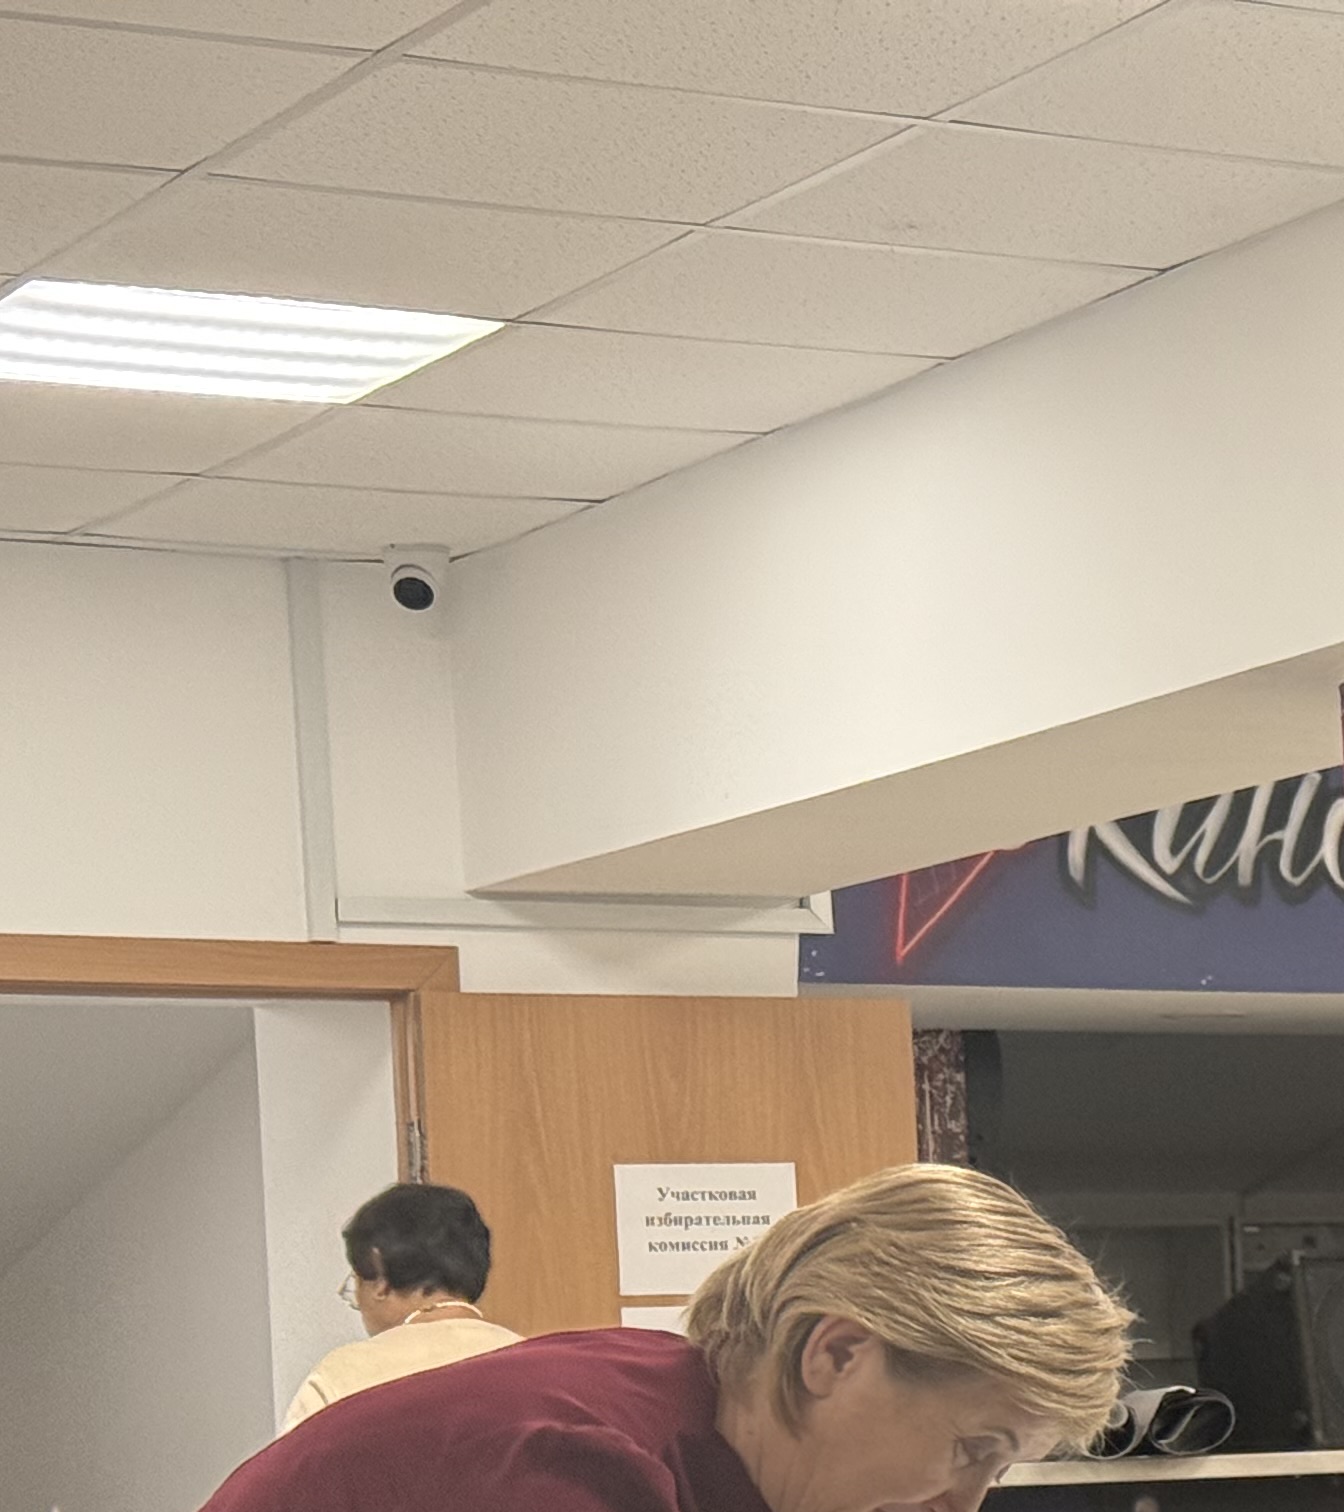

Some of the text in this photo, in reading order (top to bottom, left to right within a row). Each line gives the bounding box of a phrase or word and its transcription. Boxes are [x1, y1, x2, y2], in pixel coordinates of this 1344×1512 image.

[657, 1187, 757, 1201] Участковая
[645, 1212, 770, 1230] избирательная
[648, 1239, 728, 1252] комиссия
